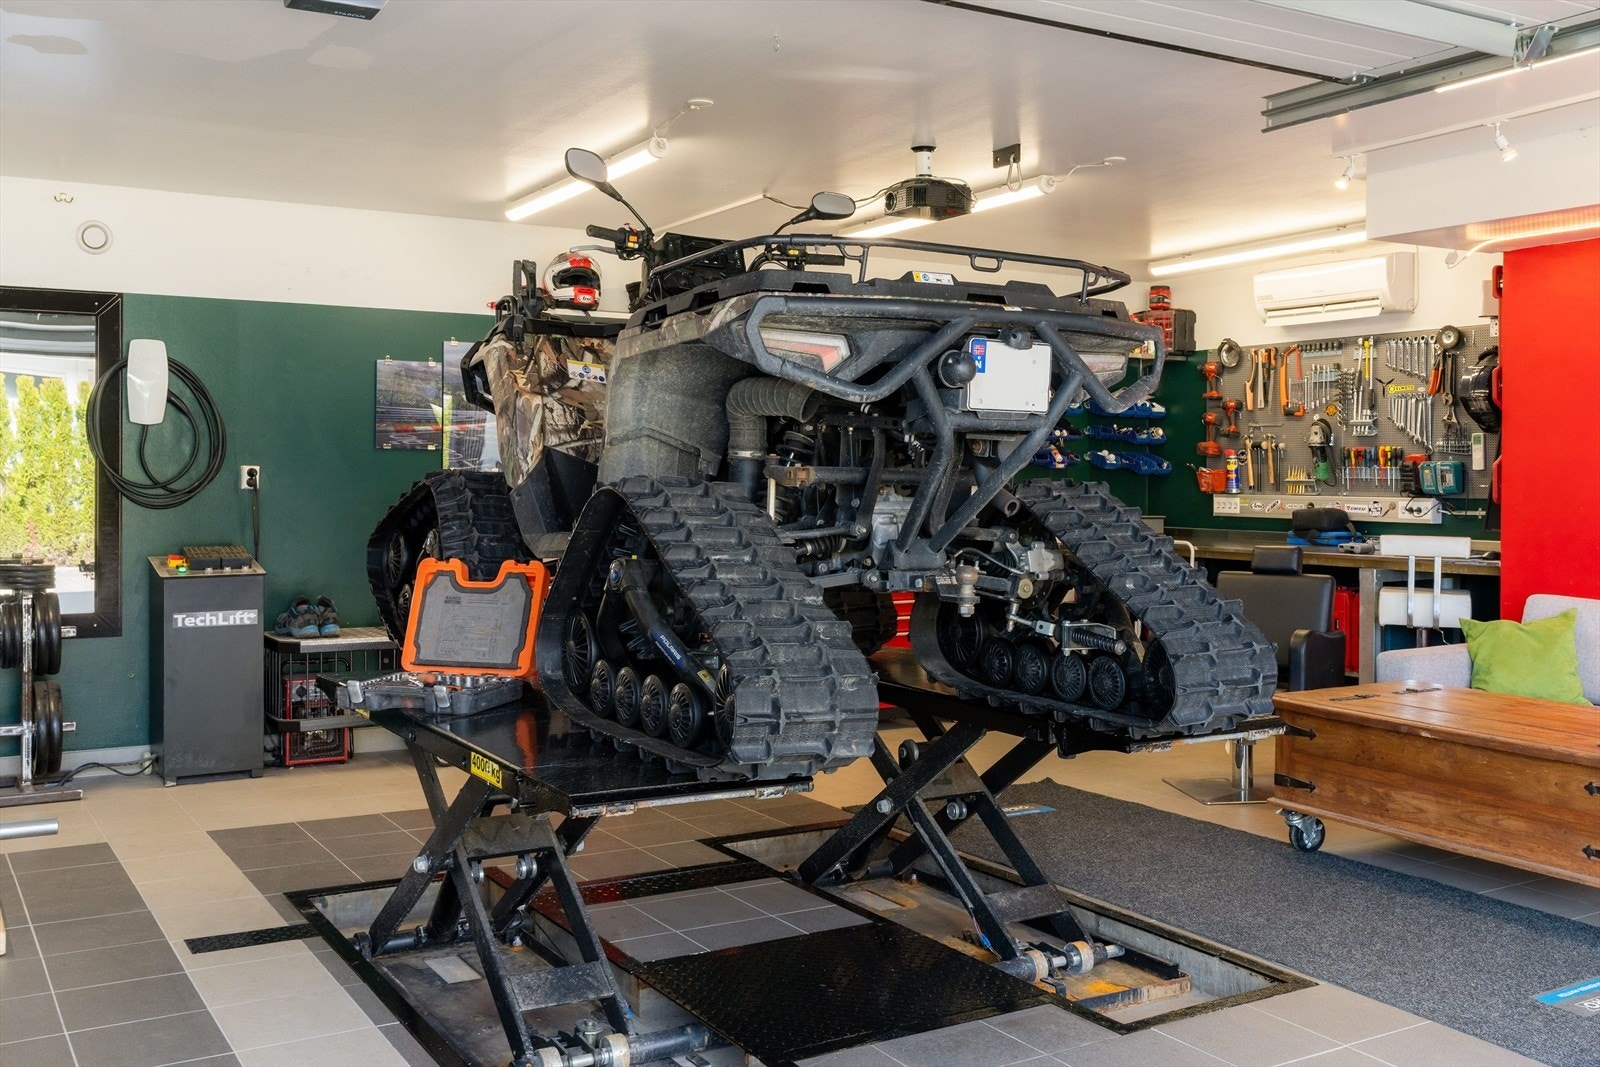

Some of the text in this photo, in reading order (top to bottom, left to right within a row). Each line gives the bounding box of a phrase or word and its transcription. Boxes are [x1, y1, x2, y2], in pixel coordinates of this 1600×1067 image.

[173, 611, 256, 627] TechLift
[660, 635, 681, 660] POLARIS
[491, 762, 501, 784] kg
